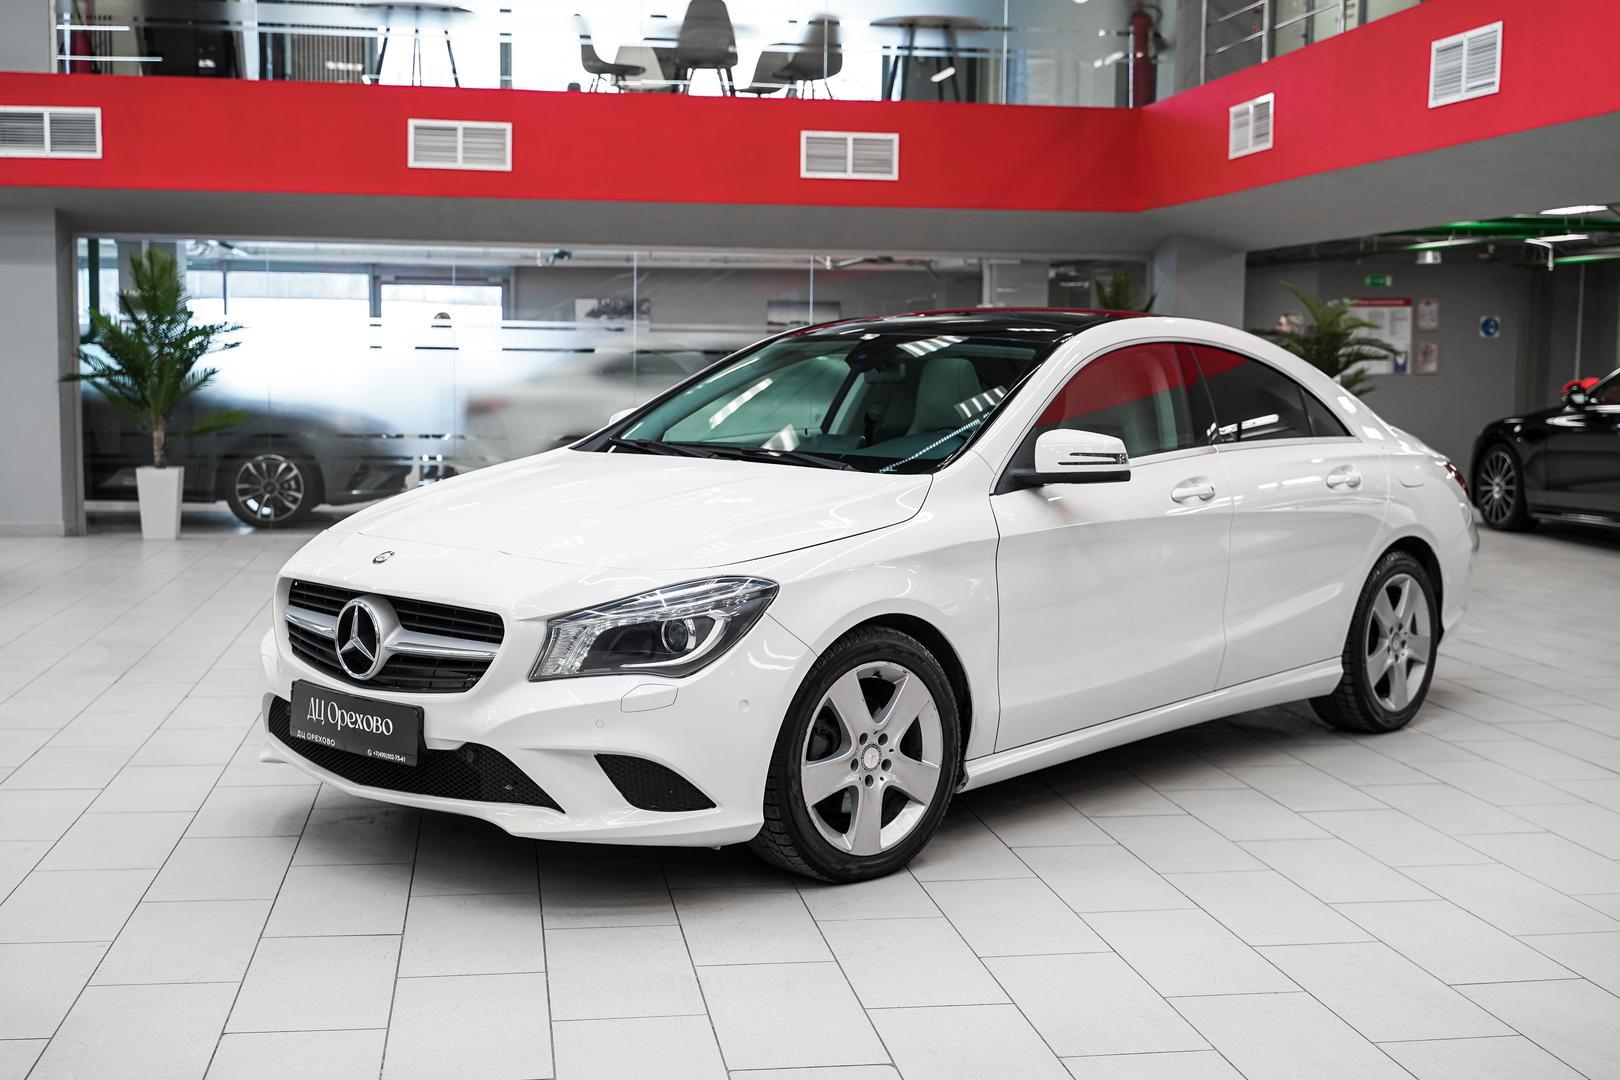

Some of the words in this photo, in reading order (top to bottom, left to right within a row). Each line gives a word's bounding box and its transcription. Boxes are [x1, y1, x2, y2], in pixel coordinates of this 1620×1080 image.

[307, 697, 325, 725] ДЦ
[328, 702, 393, 736] Орехово
[296, 730, 306, 739] ДЦ
[306, 732, 336, 746] ОРЕХОВО
